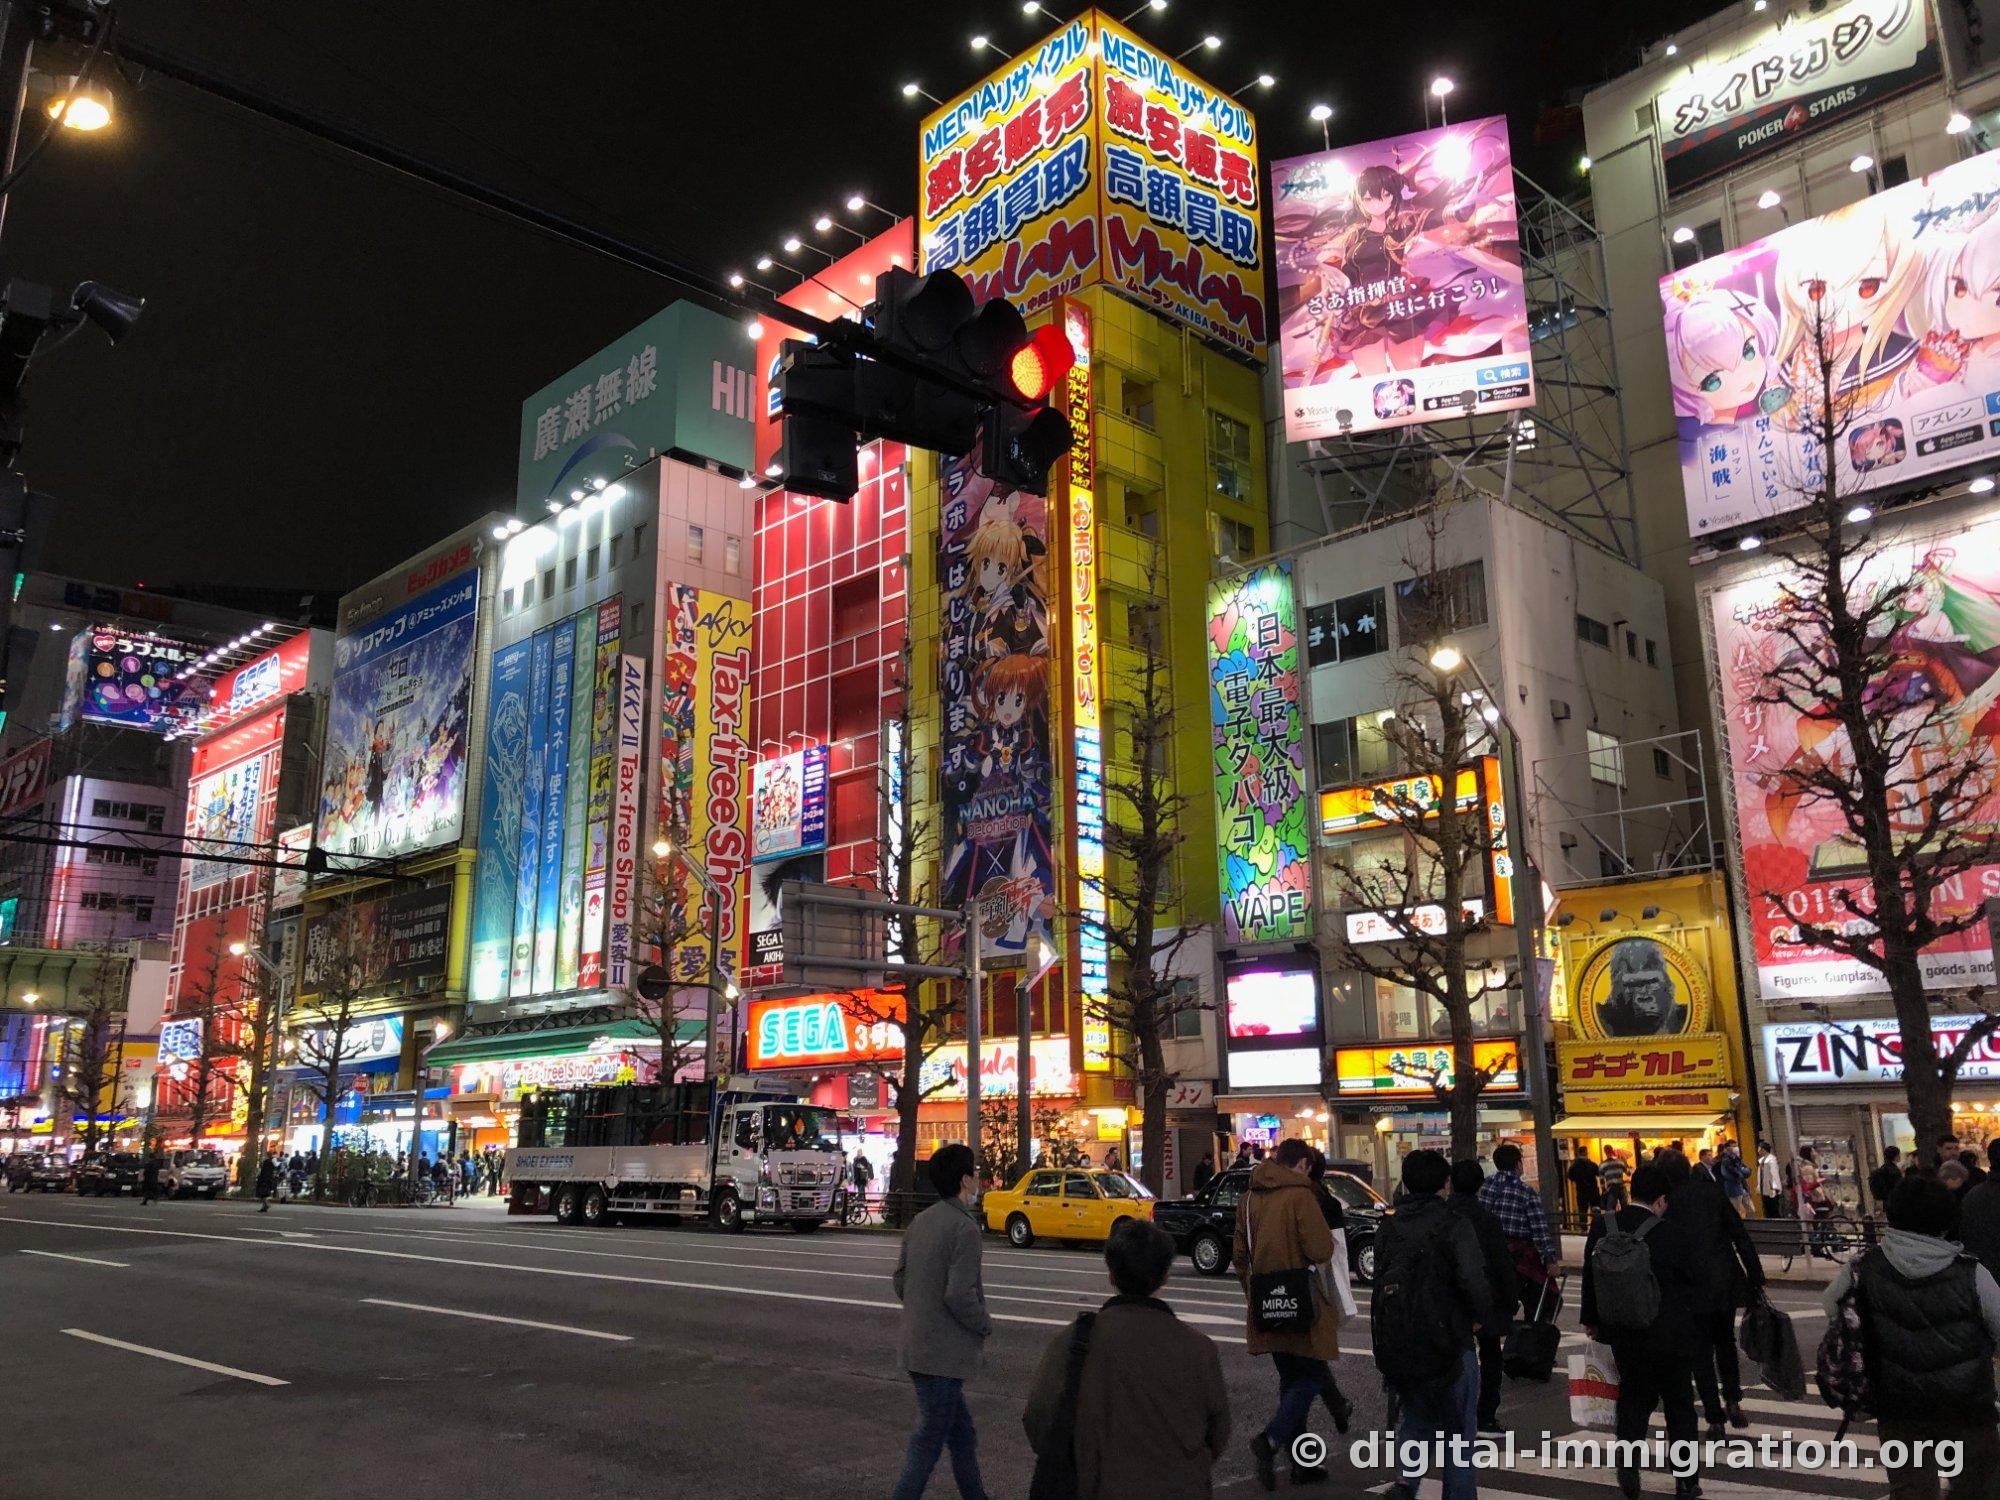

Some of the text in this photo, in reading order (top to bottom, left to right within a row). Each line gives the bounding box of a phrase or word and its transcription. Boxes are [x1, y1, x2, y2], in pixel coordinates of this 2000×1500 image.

[924, 20, 1090, 162] MEDIAリサイクル
[1101, 28, 1254, 145] MEDIAリサイクル
[926, 68, 1092, 219] 激安販売
[1105, 74, 1256, 205] 激安販売
[1737, 119, 1784, 150] POKER
[1808, 86, 1857, 118] STARS
[925, 137, 1090, 275] 高額買取
[1105, 146, 1255, 262] 高額買取
[963, 218, 1098, 304] ulan
[1107, 215, 1266, 342] Mulan
[1125, 276, 1175, 311] ムーラン
[1175, 303, 1209, 330] AKIBA
[1306, 275, 1419, 315] さあ指揮官、
[534, 344, 658, 461] 廣瀬無線
[1918, 407, 1972, 430] アズレン
[622, 660, 642, 728] AKKY
[1256, 612, 1292, 804] 日本最大級
[707, 648, 750, 828] Tax-free
[1223, 669, 1258, 845] 電子タバコ
[615, 753, 638, 853] Tax-free
[958, 792, 1035, 821] NANOHA
[968, 814, 1032, 839] Detonation
[611, 858, 634, 919] Shop
[1229, 890, 1306, 931] VAPE
[611, 922, 631, 964] 愛客
[757, 933, 778, 947] SEGA
[1926, 961, 1996, 979] goods and
[760, 1002, 848, 1058] SEGA
[1775, 1026, 1812, 1037] COMIC
[1776, 1024, 1869, 1078] ZIN
[1262, 1297, 1298, 1310] MIRAS
[1262, 1311, 1298, 1319] UNIVERSITY
